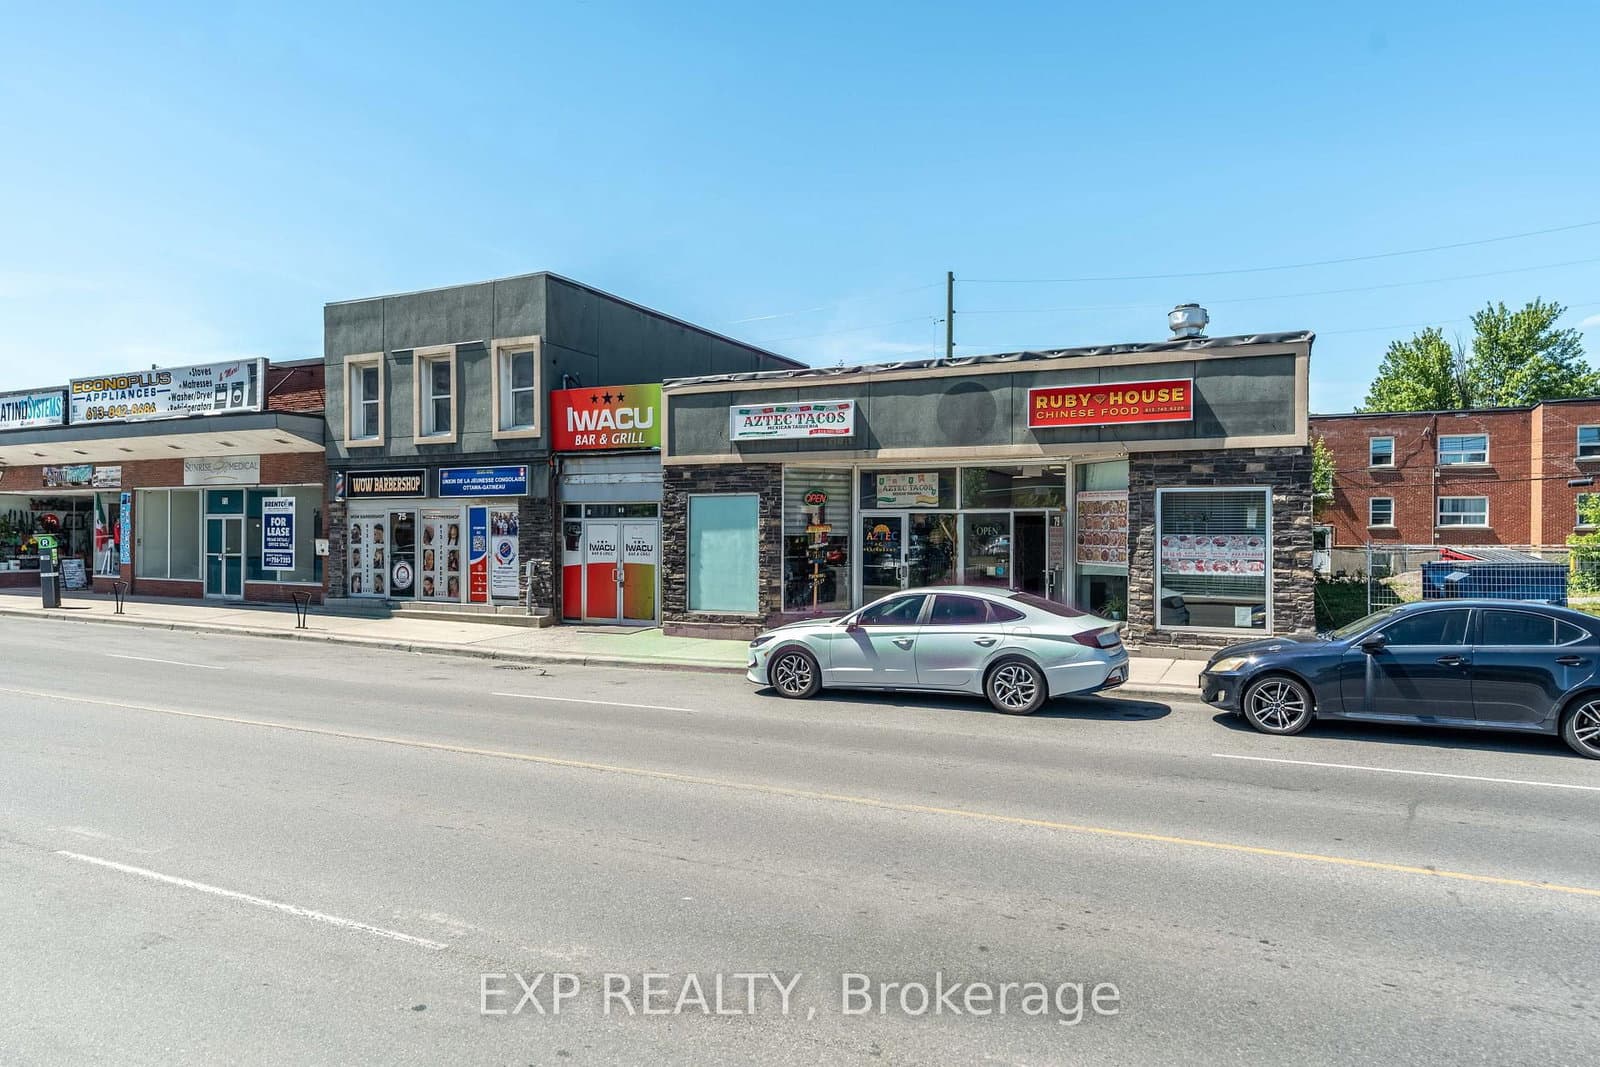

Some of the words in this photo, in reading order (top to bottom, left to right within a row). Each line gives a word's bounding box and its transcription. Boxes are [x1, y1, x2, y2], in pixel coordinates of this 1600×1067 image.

[192, 368, 212, 376] Stoves
[72, 372, 172, 394] ECONOPLUS
[86, 388, 156, 402] APPLIANCES
[171, 391, 212, 401] Washer/Dryer
[1036, 394, 1091, 409] RUBY
[1109, 388, 1184, 405] HOUSE
[1036, 408, 1095, 419] CHINESE
[1101, 407, 1139, 416] FOOD
[566, 406, 654, 432] IWACU
[744, 414, 792, 427] AZTEC
[795, 411, 846, 425] TACOS
[575, 434, 596, 446] BAR
[600, 434, 608, 445] &
[611, 432, 645, 444] GRILL
[185, 462, 211, 472] SUNRISE
[228, 462, 258, 470] MEDICAL
[353, 477, 373, 492] WOW
[374, 476, 420, 492] BARBERSHOP
[806, 494, 827, 503] OPEN
[398, 512, 406, 520] 75
[271, 517, 286, 527] FOR
[267, 527, 290, 536] LEASE
[976, 526, 998, 536] OPEN
[866, 532, 897, 541] AZTEC
[589, 543, 616, 551] IWACU
[626, 544, 653, 552] IWACU
